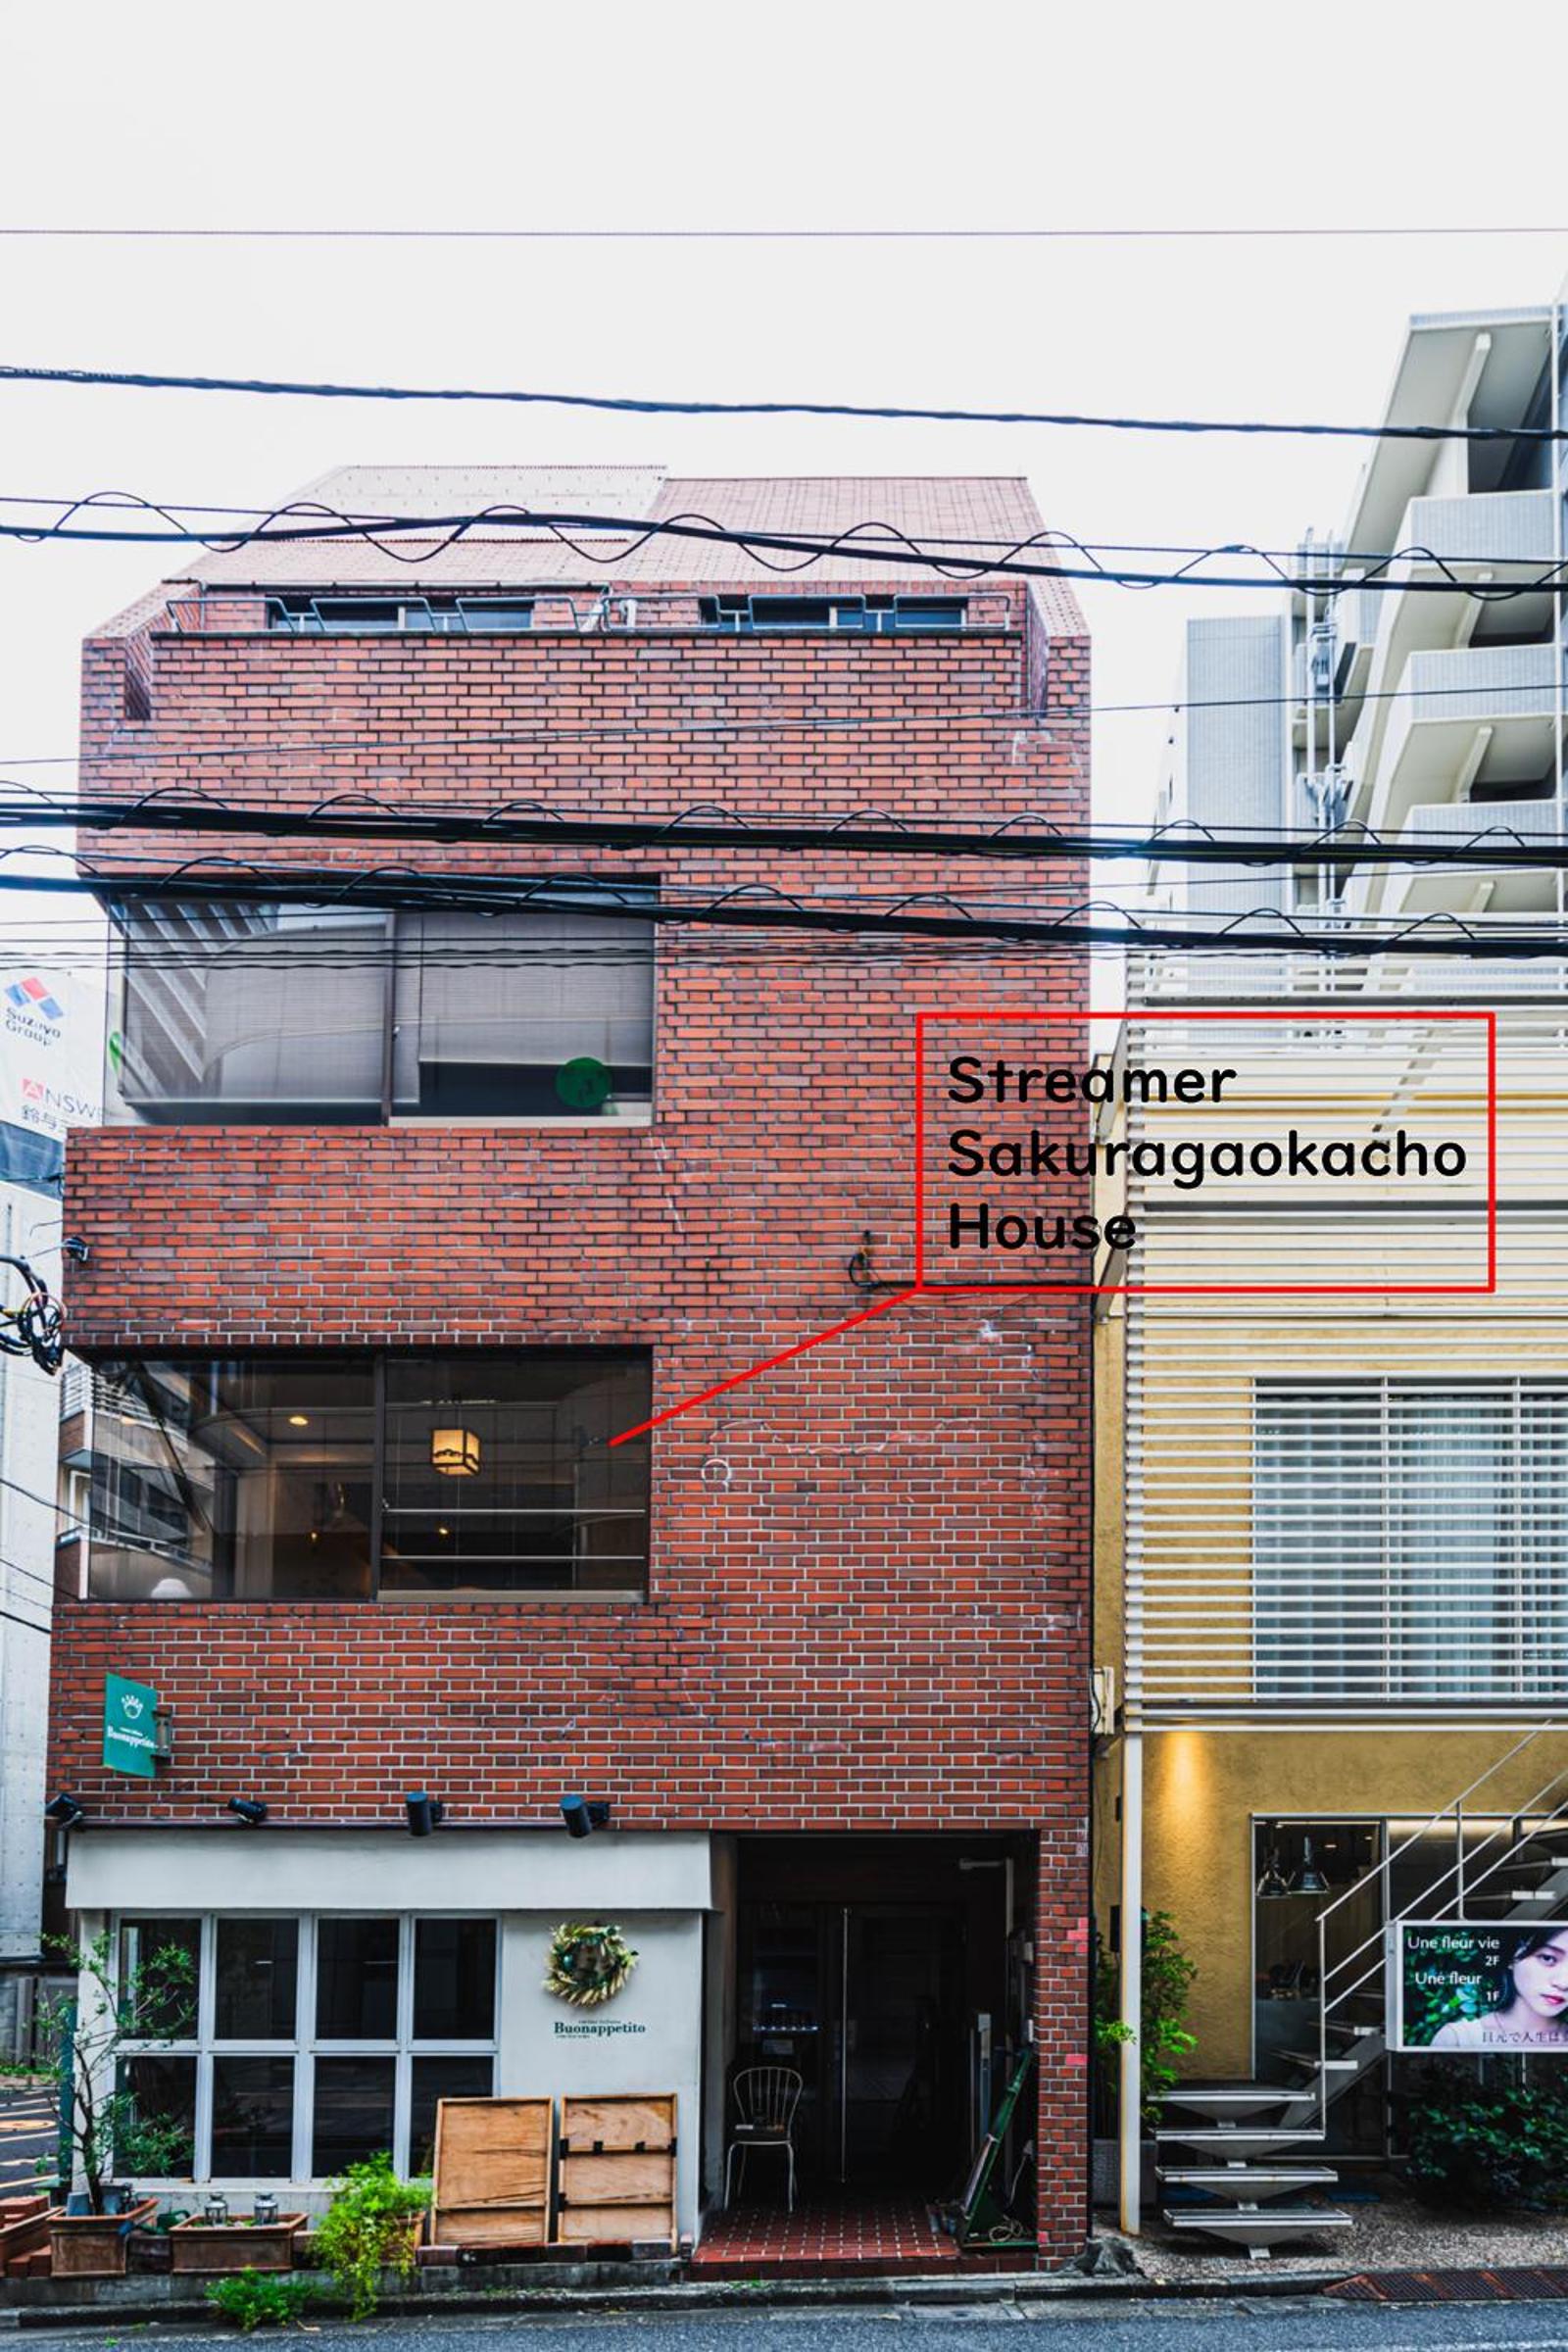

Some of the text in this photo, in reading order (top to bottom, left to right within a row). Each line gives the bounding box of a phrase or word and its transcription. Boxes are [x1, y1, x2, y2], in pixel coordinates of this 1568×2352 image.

[1407, 1936, 1500, 1949] Une fleur vie
[1485, 1955, 1500, 1967] 2F
[1415, 1971, 1482, 1984] Une fleur
[1487, 1990, 1499, 2002] 1F
[554, 2022, 646, 2037] Buonappetito
